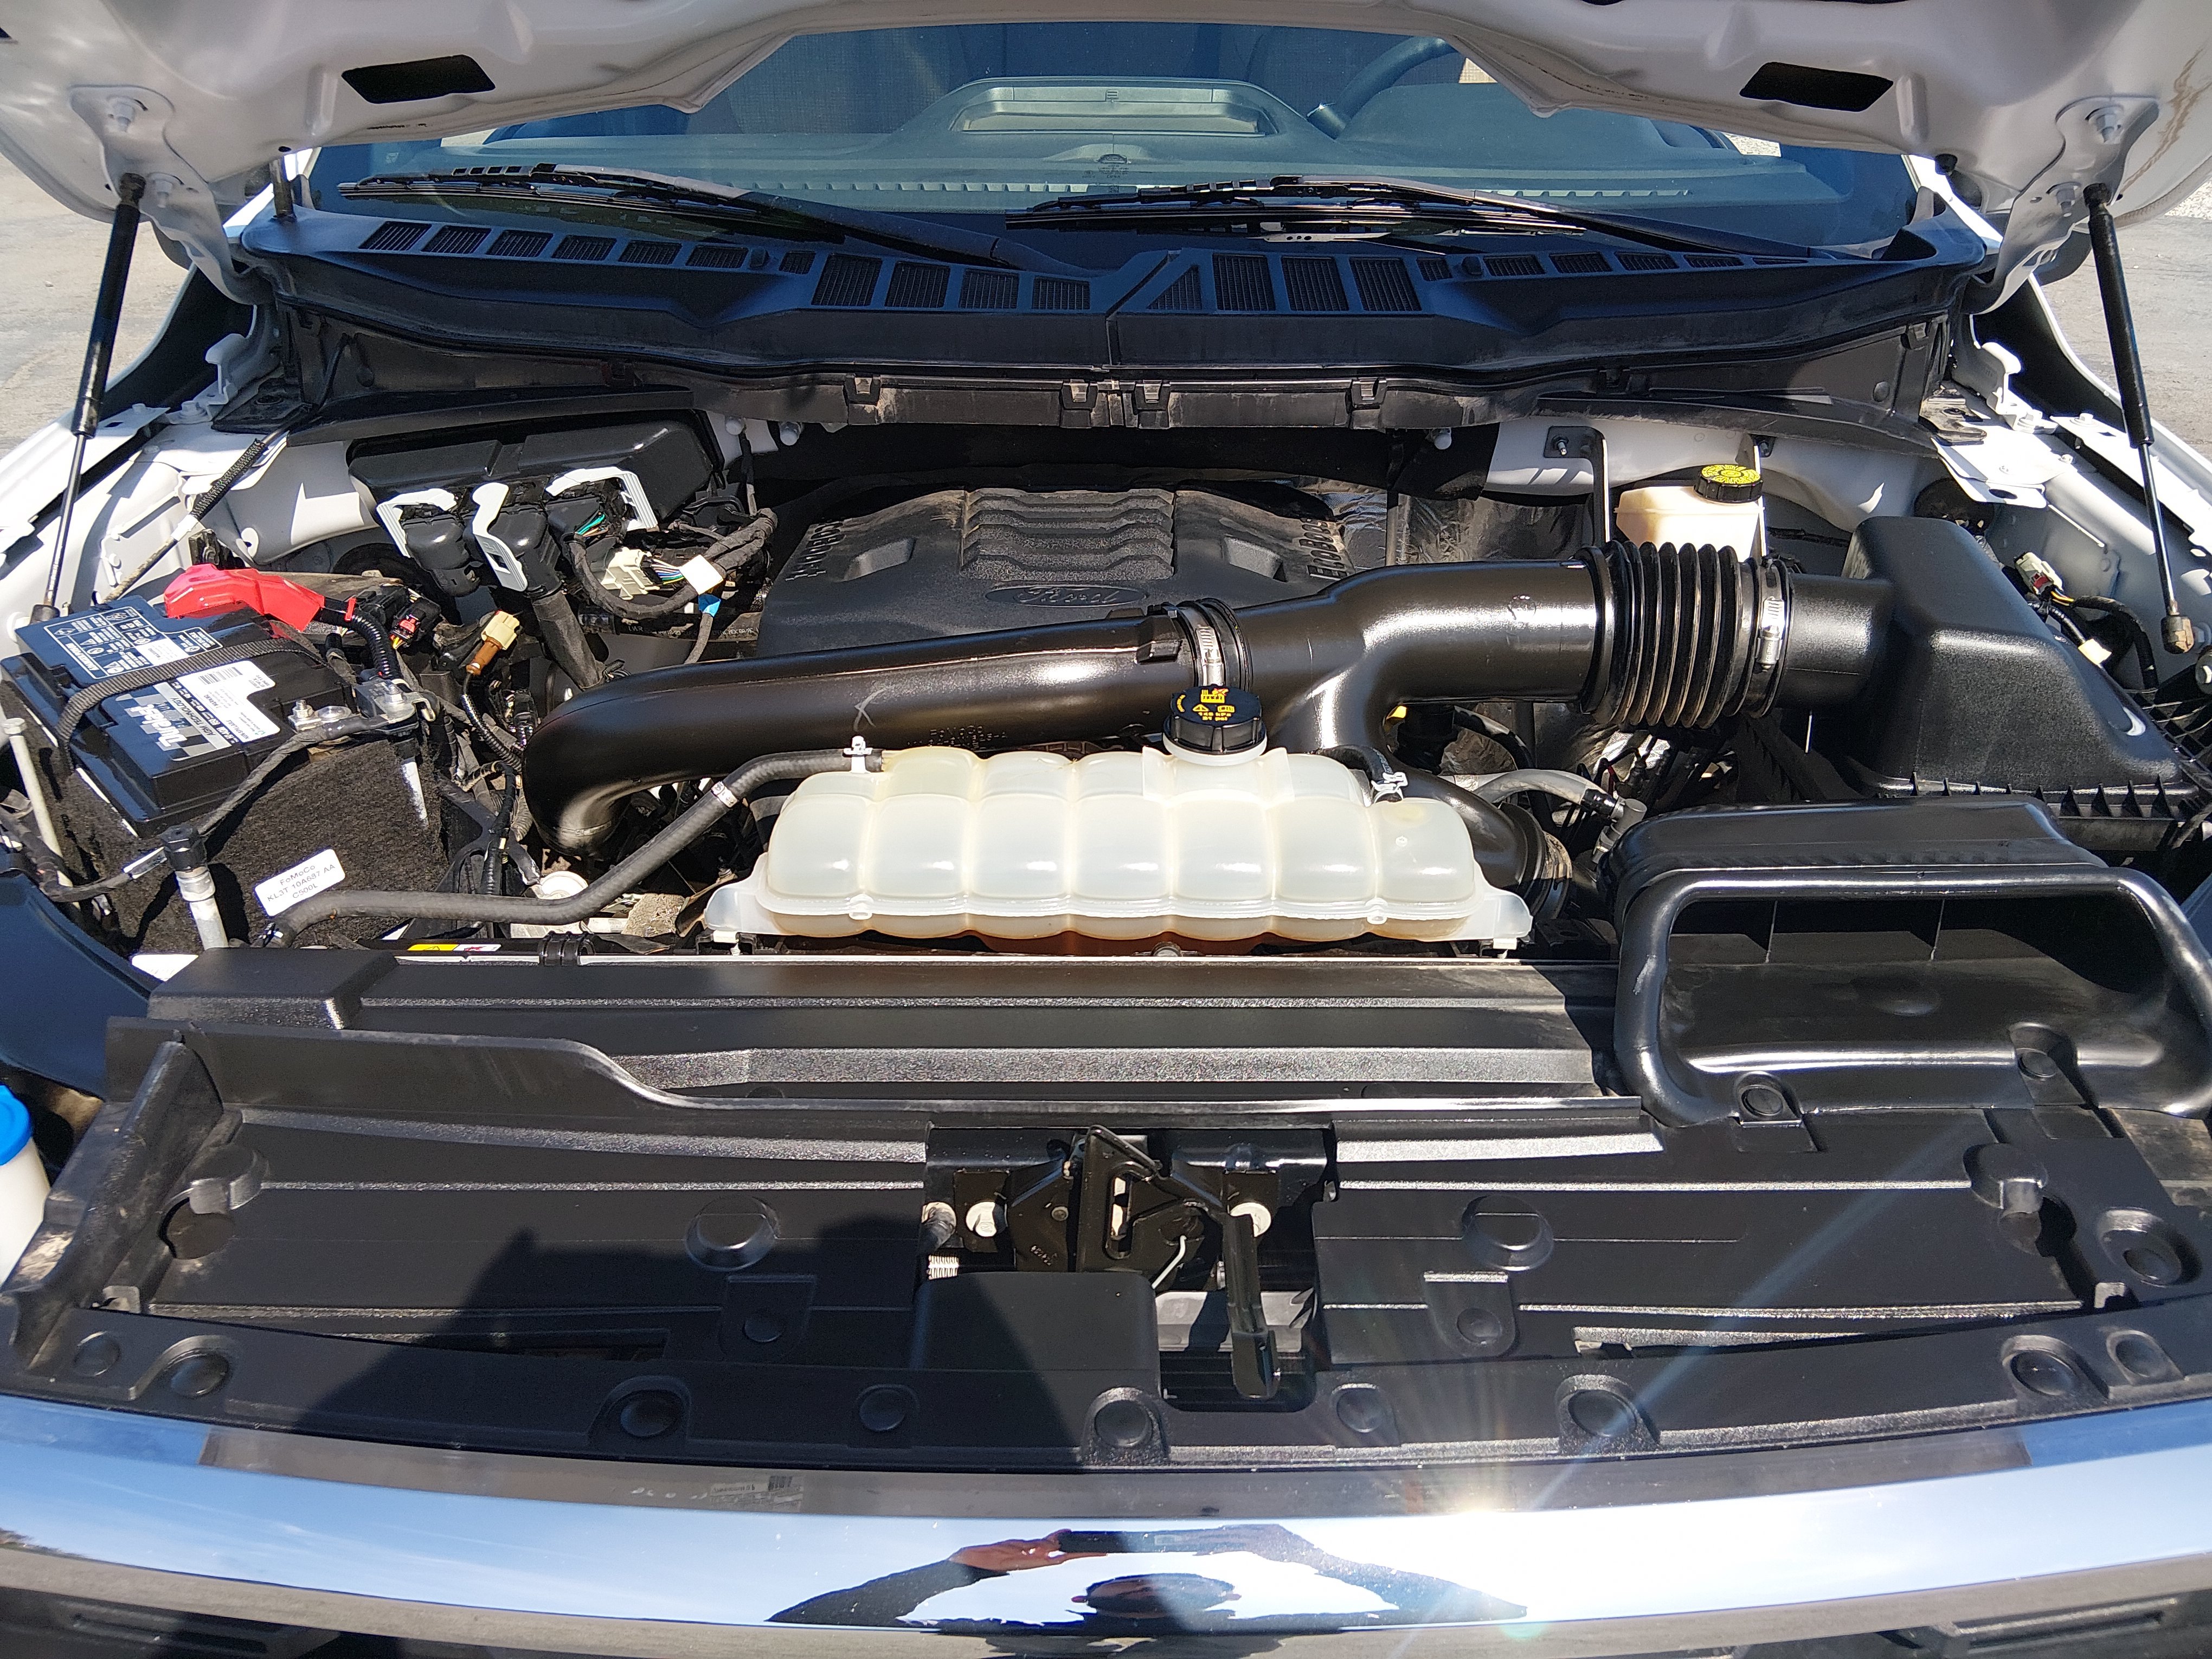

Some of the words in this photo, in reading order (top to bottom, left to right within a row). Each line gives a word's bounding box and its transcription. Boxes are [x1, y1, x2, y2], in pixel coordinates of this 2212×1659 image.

[1013, 586, 1120, 603] Ford
[170, 697, 202, 726] TECHNOLOGY
[130, 704, 188, 747] Duralast
[198, 724, 216, 737] AGM
[267, 887, 289, 902] KL3T
[324, 864, 336, 873] AA
[280, 865, 316, 885] FoMoCo
[292, 883, 318, 898] C500L
